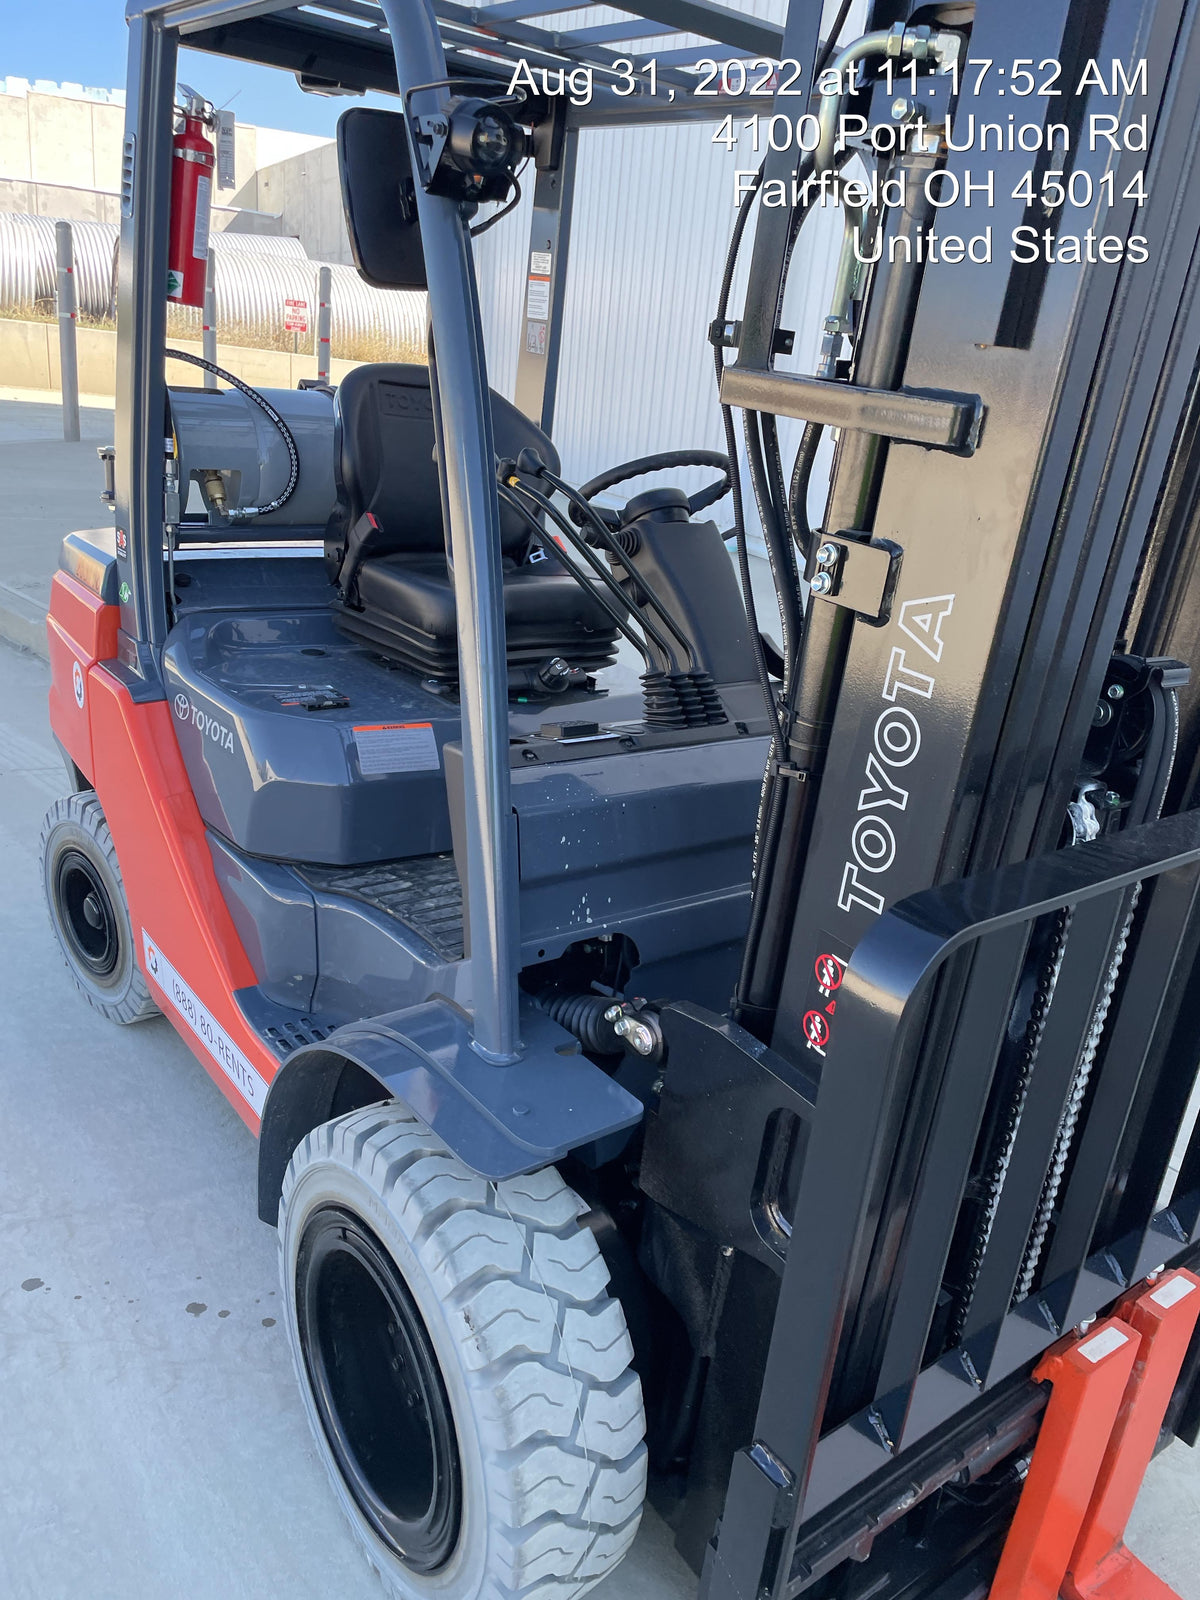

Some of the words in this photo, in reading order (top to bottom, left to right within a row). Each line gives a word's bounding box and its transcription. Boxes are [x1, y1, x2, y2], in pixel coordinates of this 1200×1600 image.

[286, 314, 306, 322] PARKING
[190, 704, 235, 754] TOYOTA
[837, 593, 956, 915] TOYOTA
[172, 979, 198, 1025] (888)
[200, 1015, 255, 1097] 80-RENTS
